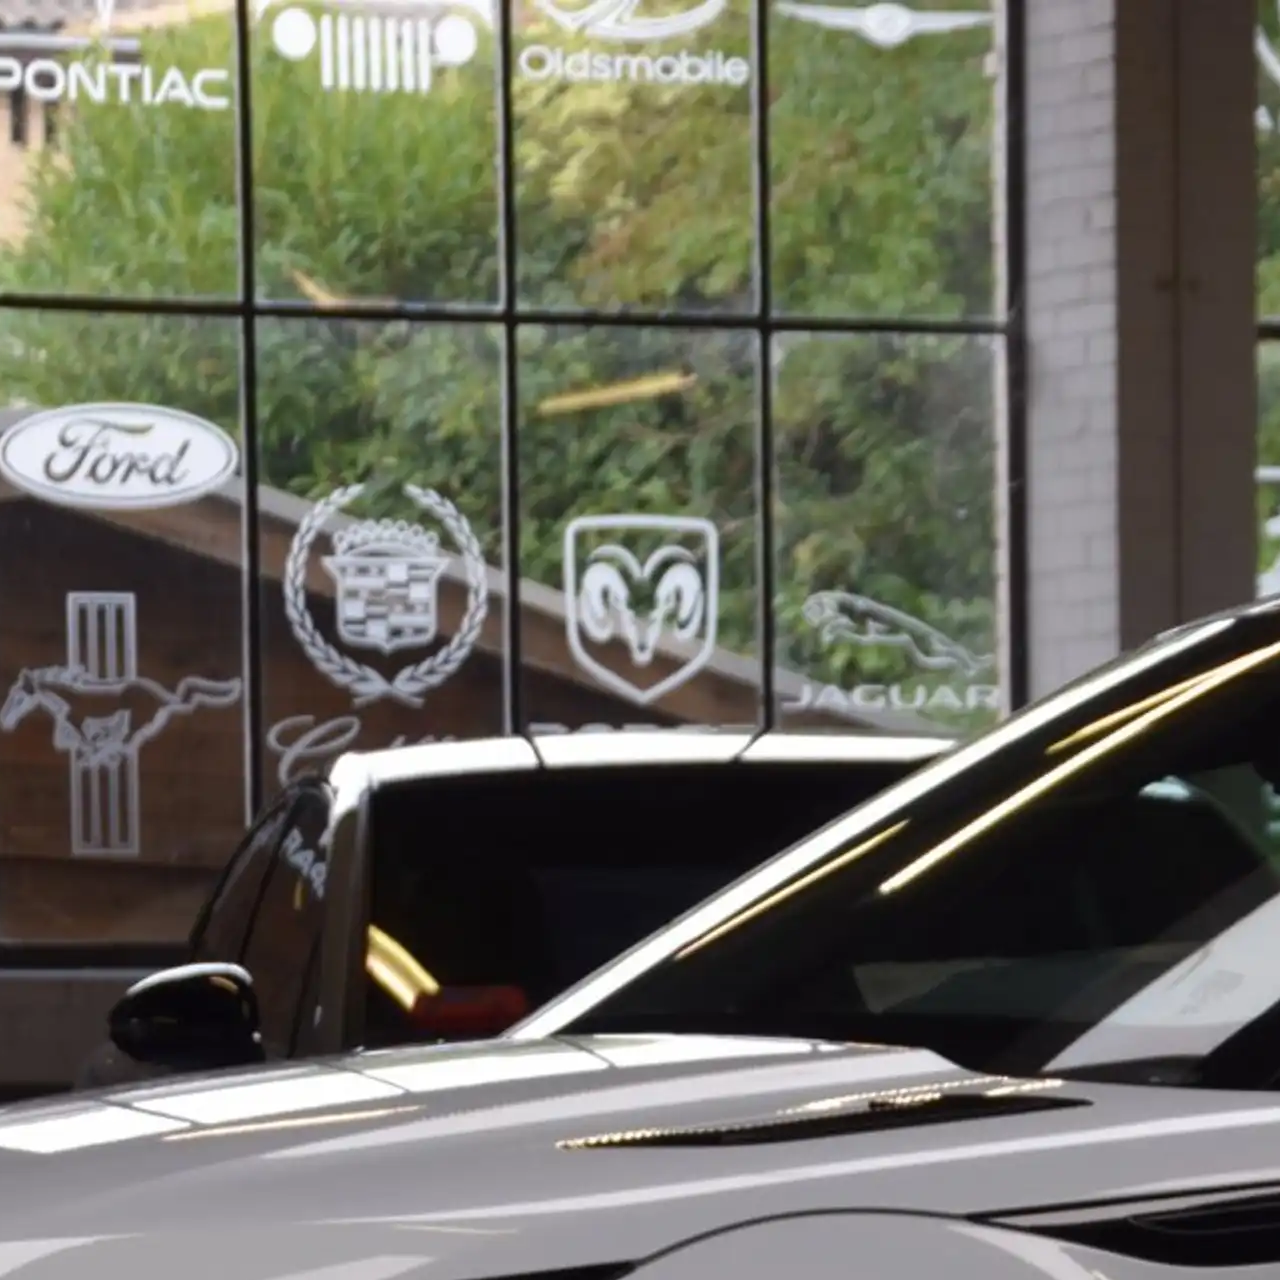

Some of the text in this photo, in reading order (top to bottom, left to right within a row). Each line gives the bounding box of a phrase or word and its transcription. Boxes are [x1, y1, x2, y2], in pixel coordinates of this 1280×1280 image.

[519, 43, 750, 86] Oldsmobile
[43, 417, 191, 487] Ford
[780, 683, 999, 711] JAGUAR
